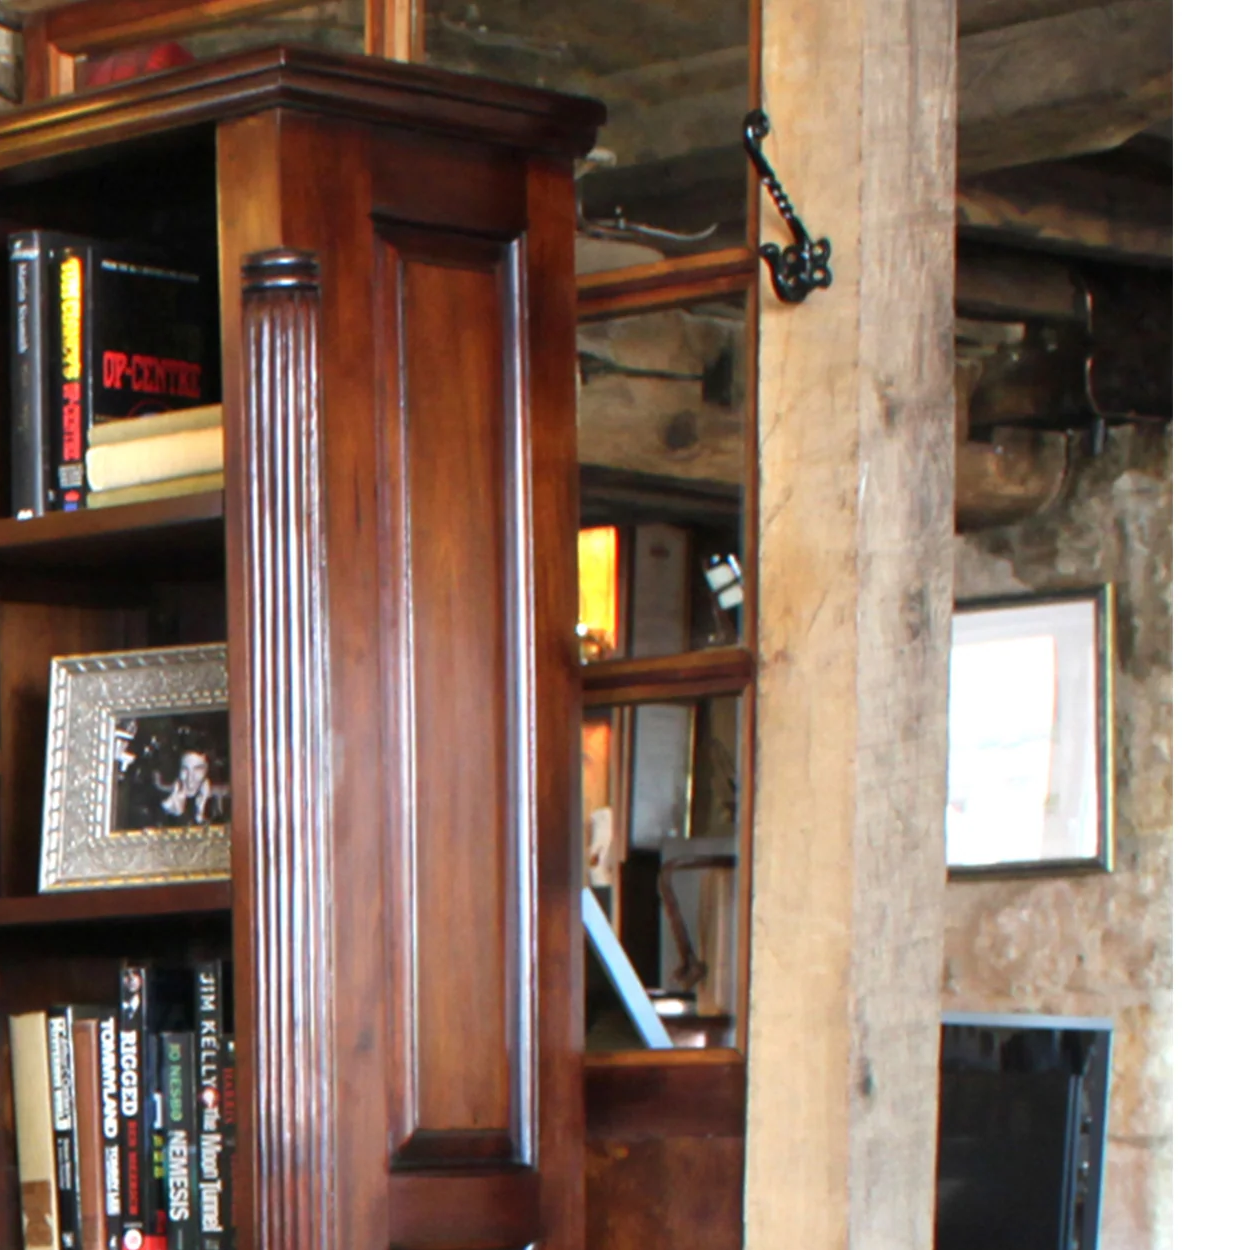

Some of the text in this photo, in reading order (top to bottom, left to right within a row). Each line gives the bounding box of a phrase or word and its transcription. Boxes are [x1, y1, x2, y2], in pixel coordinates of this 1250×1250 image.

[102, 351, 201, 398] OP-CENTRE
[121, 1030, 138, 1117] RIGGED
[199, 973, 218, 1087] JIM KELLY
[100, 1017, 119, 1139] TOMMYLAND
[169, 1130, 189, 1221] NEMESIS
[200, 1133, 222, 1178] Moon
[201, 1178, 223, 1233] Tunnel
